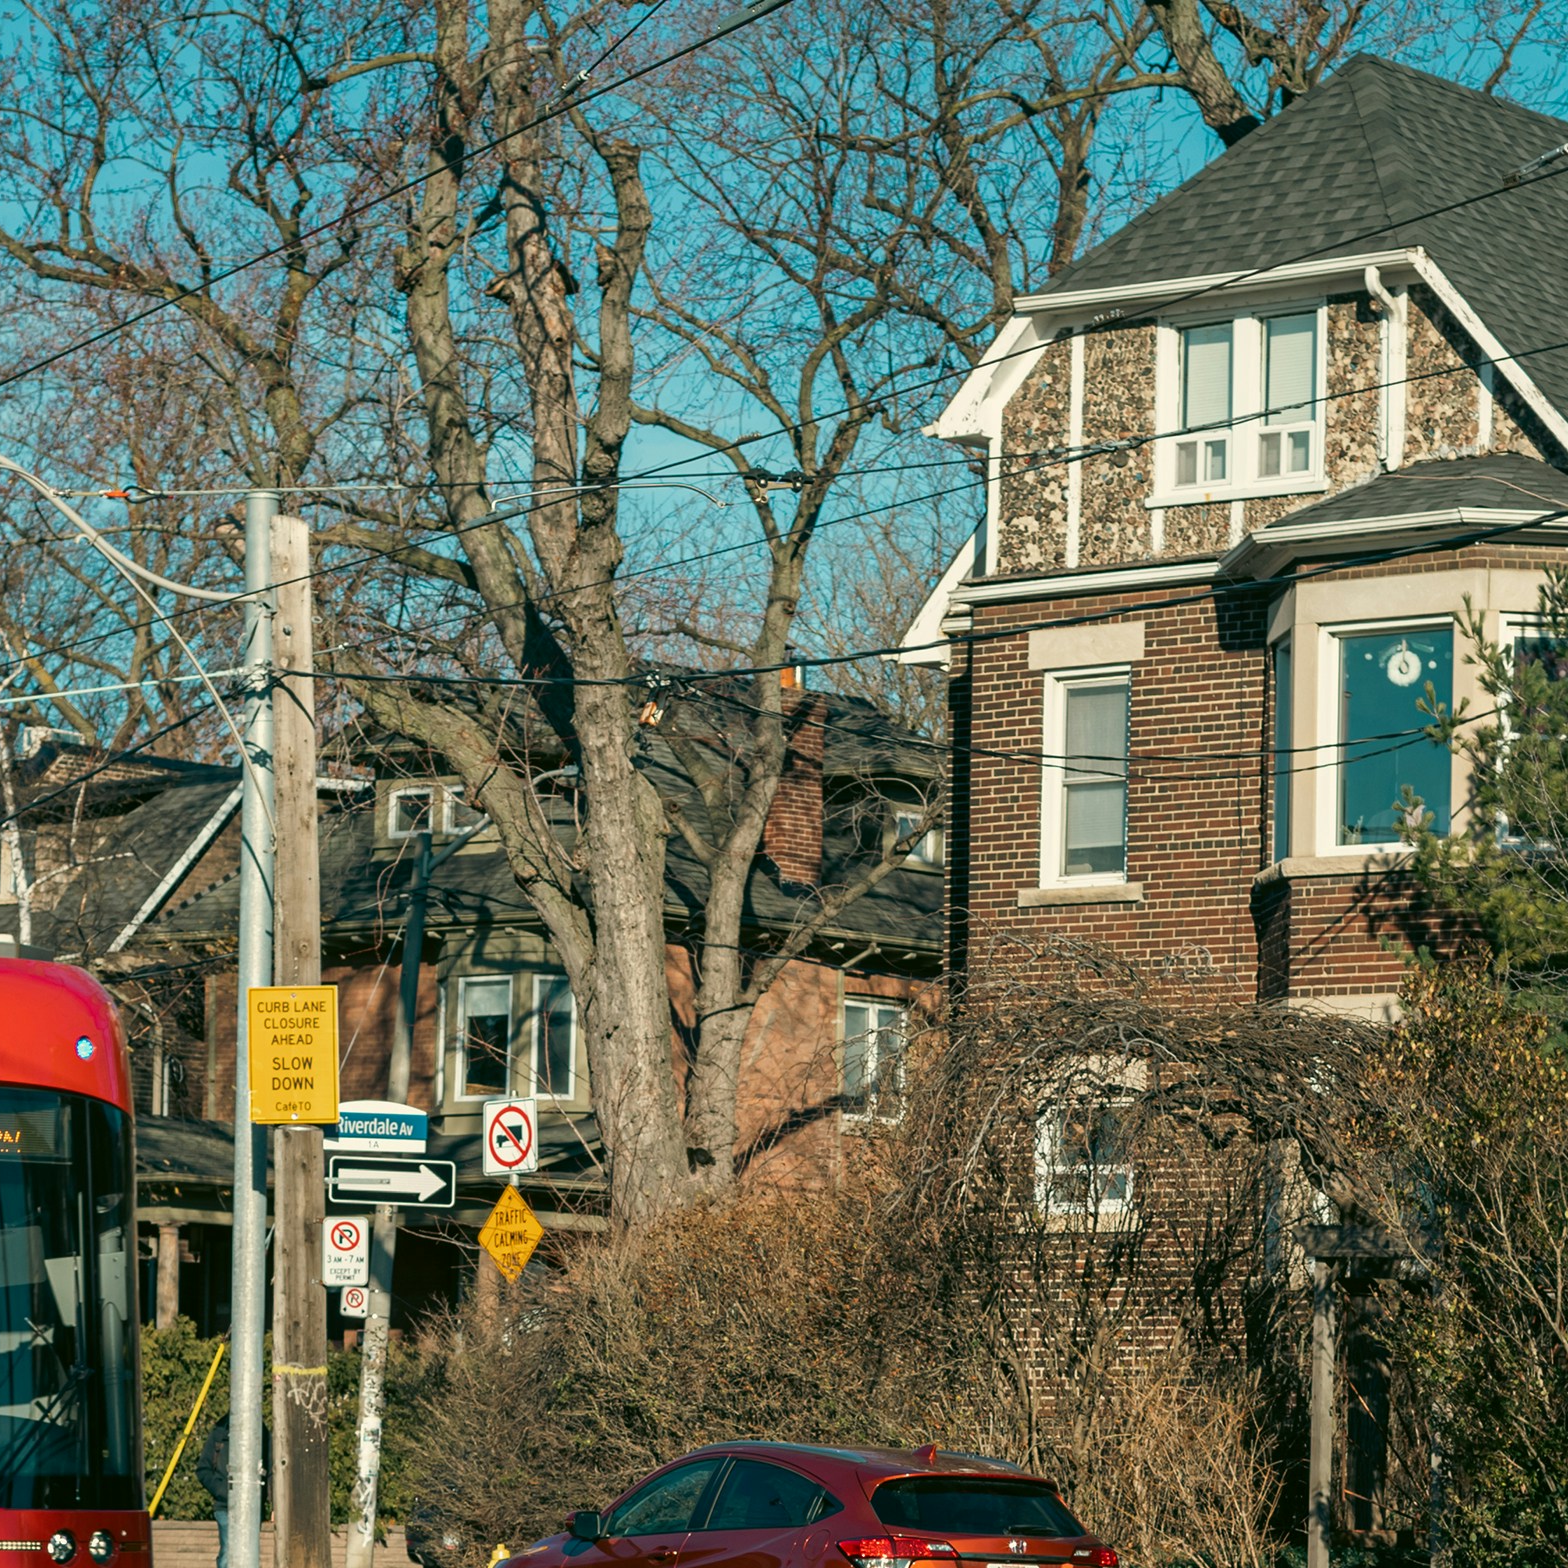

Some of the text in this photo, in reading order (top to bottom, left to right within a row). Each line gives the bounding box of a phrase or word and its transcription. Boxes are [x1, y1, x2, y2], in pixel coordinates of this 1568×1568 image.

[257, 1001, 326, 1013] CURB LANE
[264, 1018, 320, 1029] CLOSURE
[271, 1034, 313, 1046] AHEAD
[272, 1057, 313, 1071] SLOW
[272, 1077, 314, 1091] DOWN
[336, 1116, 413, 1136] Riverdale Av
[495, 1208, 528, 1227] TRAFFIC
[494, 1229, 529, 1249] CALMING
[327, 1255, 332, 1263] 3
[349, 1255, 354, 1263] 7
[502, 1251, 522, 1268] ZONE
